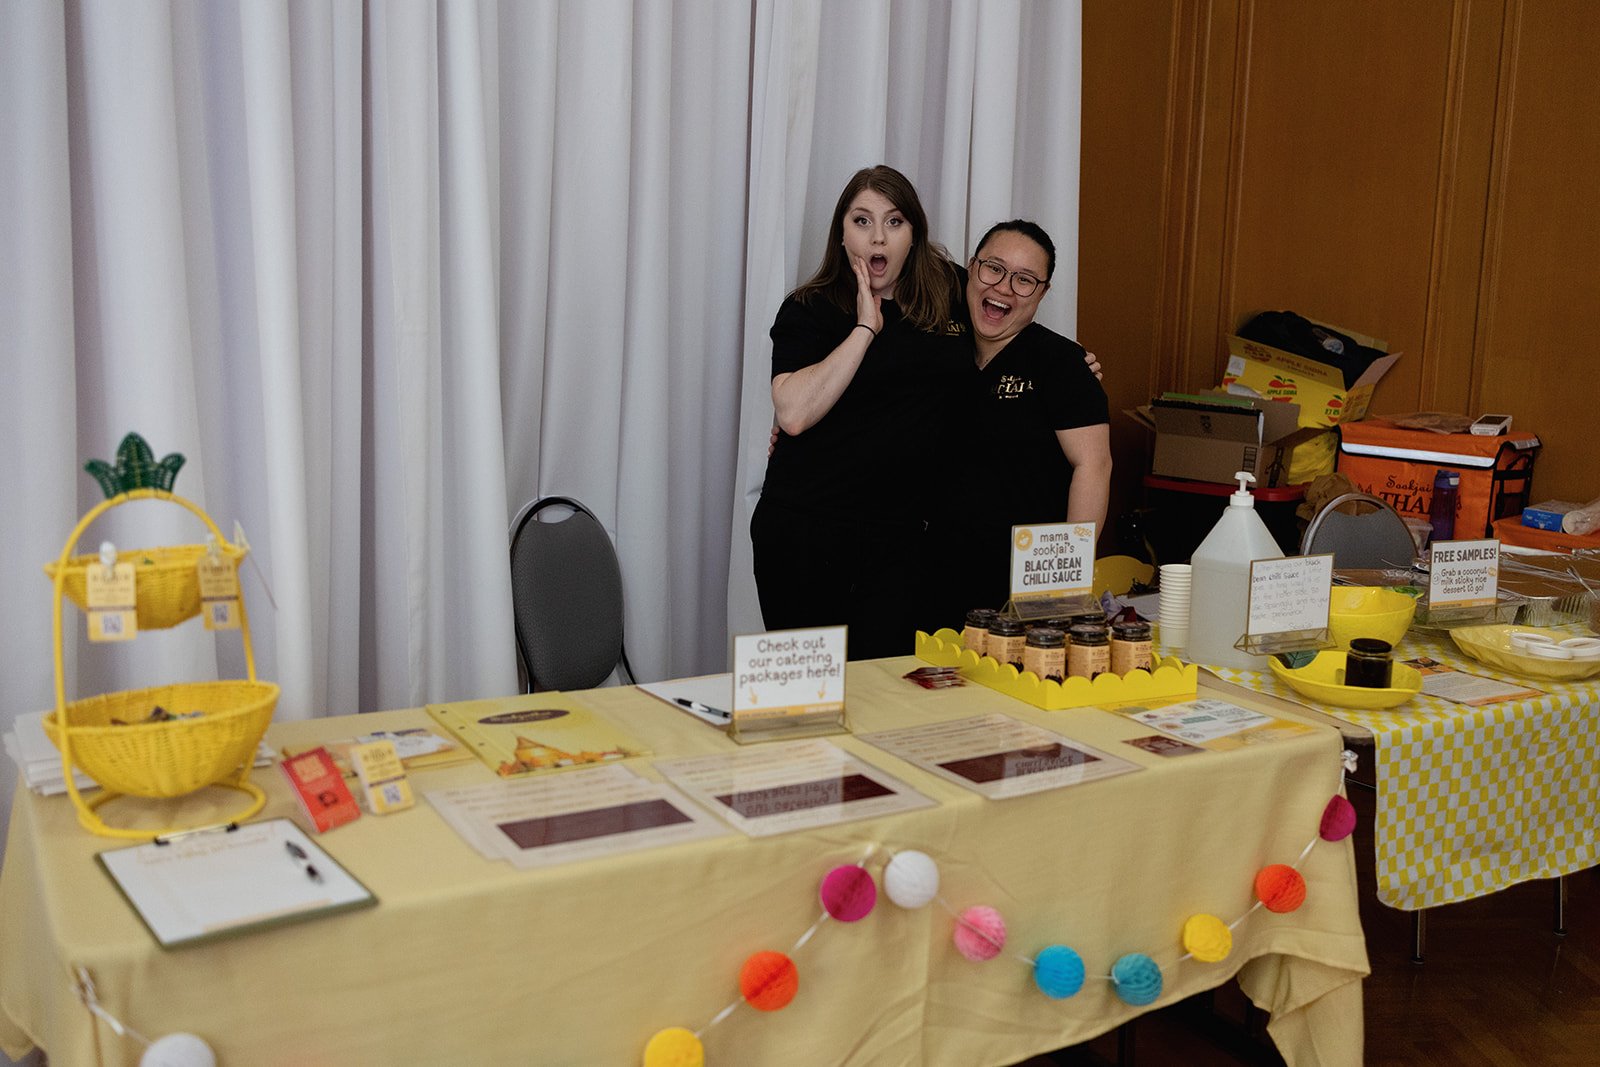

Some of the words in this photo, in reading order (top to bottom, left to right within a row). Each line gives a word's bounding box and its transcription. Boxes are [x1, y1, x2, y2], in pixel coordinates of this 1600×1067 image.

[1386, 474, 1432, 496] Sookjai
[1040, 533, 1069, 542] mama
[1033, 542, 1075, 558] sookjai's
[1433, 550, 1455, 563] FREE
[1456, 548, 1497, 561] SAMPLES!
[1025, 560, 1055, 572] BLACK
[1057, 557, 1082, 569] BEAN
[1441, 568, 1456, 577] Grab
[1462, 567, 1487, 575] coconut
[1023, 573, 1050, 585] CHILLI
[1052, 570, 1082, 583] SAUCE
[1441, 577, 1453, 585] milk
[1455, 576, 1473, 585] sticky
[1474, 574, 1487, 583] rice
[1443, 586, 1466, 594] dessert
[1474, 585, 1484, 594] go!
[757, 638, 799, 653] Check
[802, 637, 826, 649] out
[749, 658, 770, 668] our
[776, 650, 832, 667] catering
[739, 670, 803, 688] packages
[807, 663, 841, 678] here!
